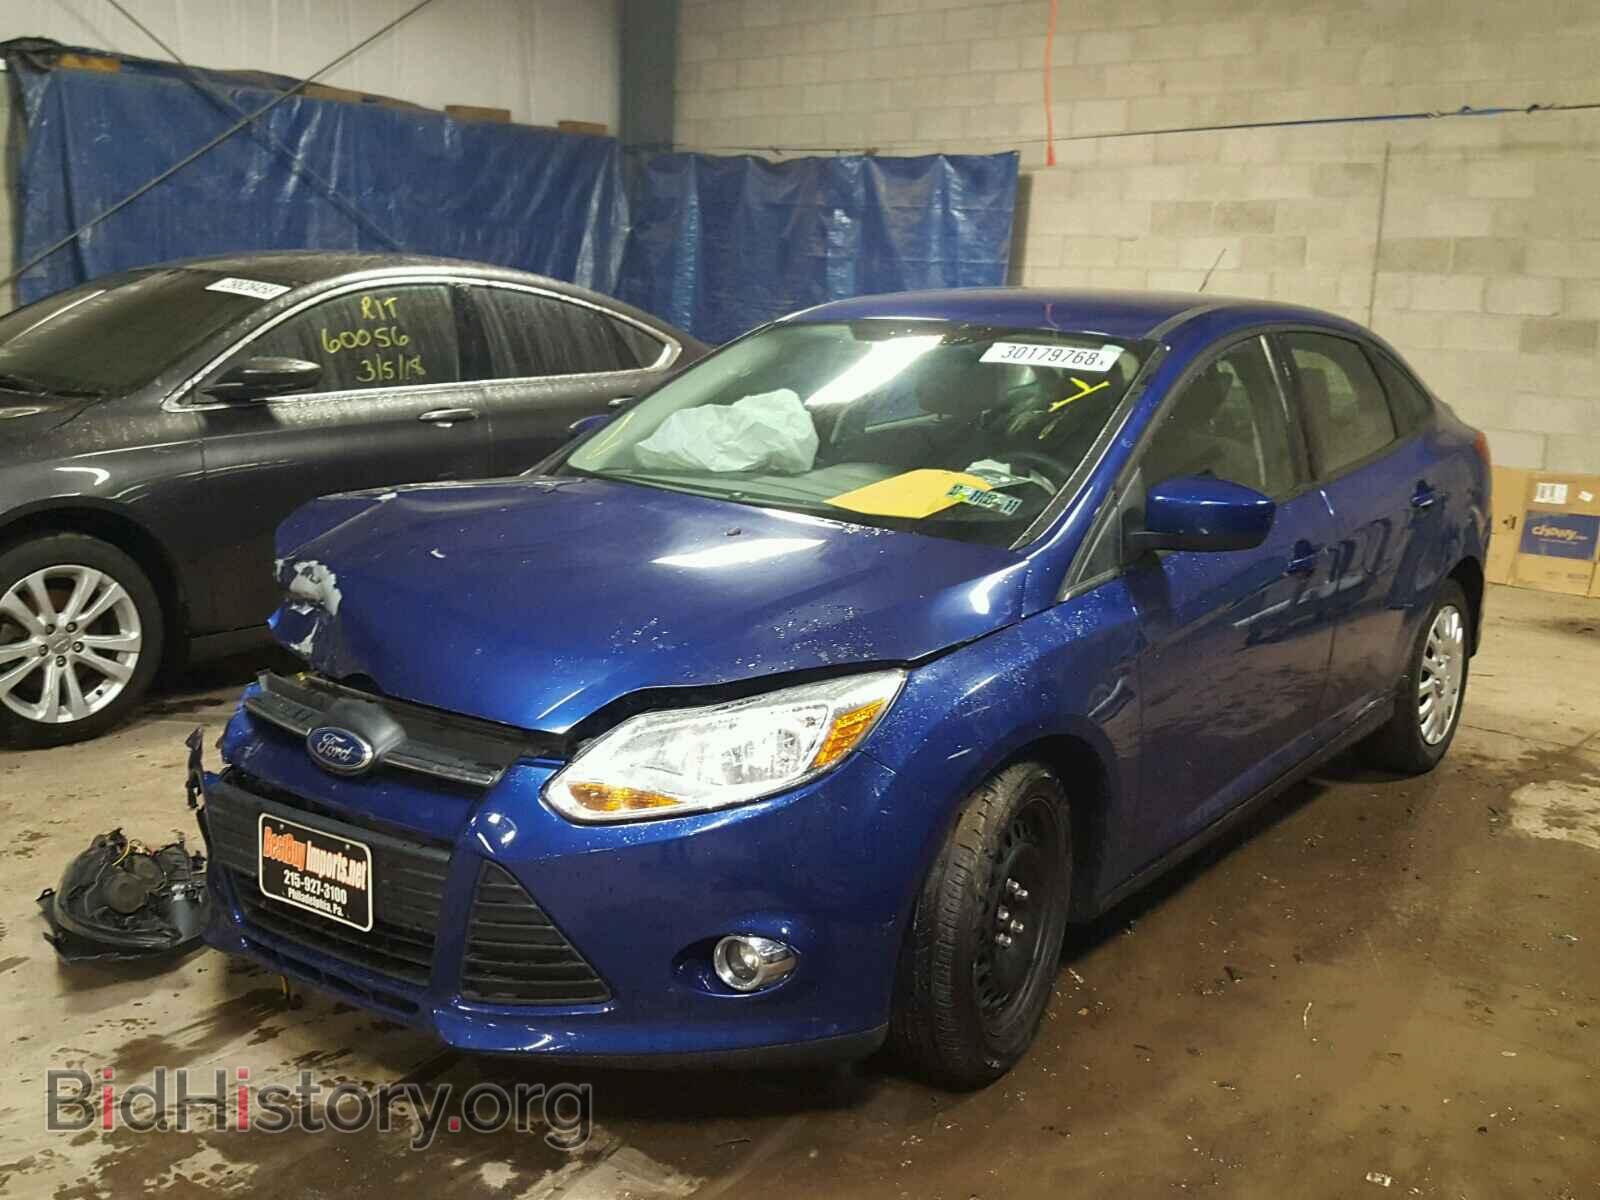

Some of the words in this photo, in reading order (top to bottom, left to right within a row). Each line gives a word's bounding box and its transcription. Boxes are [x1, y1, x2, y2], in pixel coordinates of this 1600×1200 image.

[321, 326, 411, 353] 60056
[356, 353, 426, 382] 3/5/18
[1001, 346, 1099, 366] 30179768
[317, 733, 354, 762] Ford
[283, 869, 348, 905] 215-927-3100
